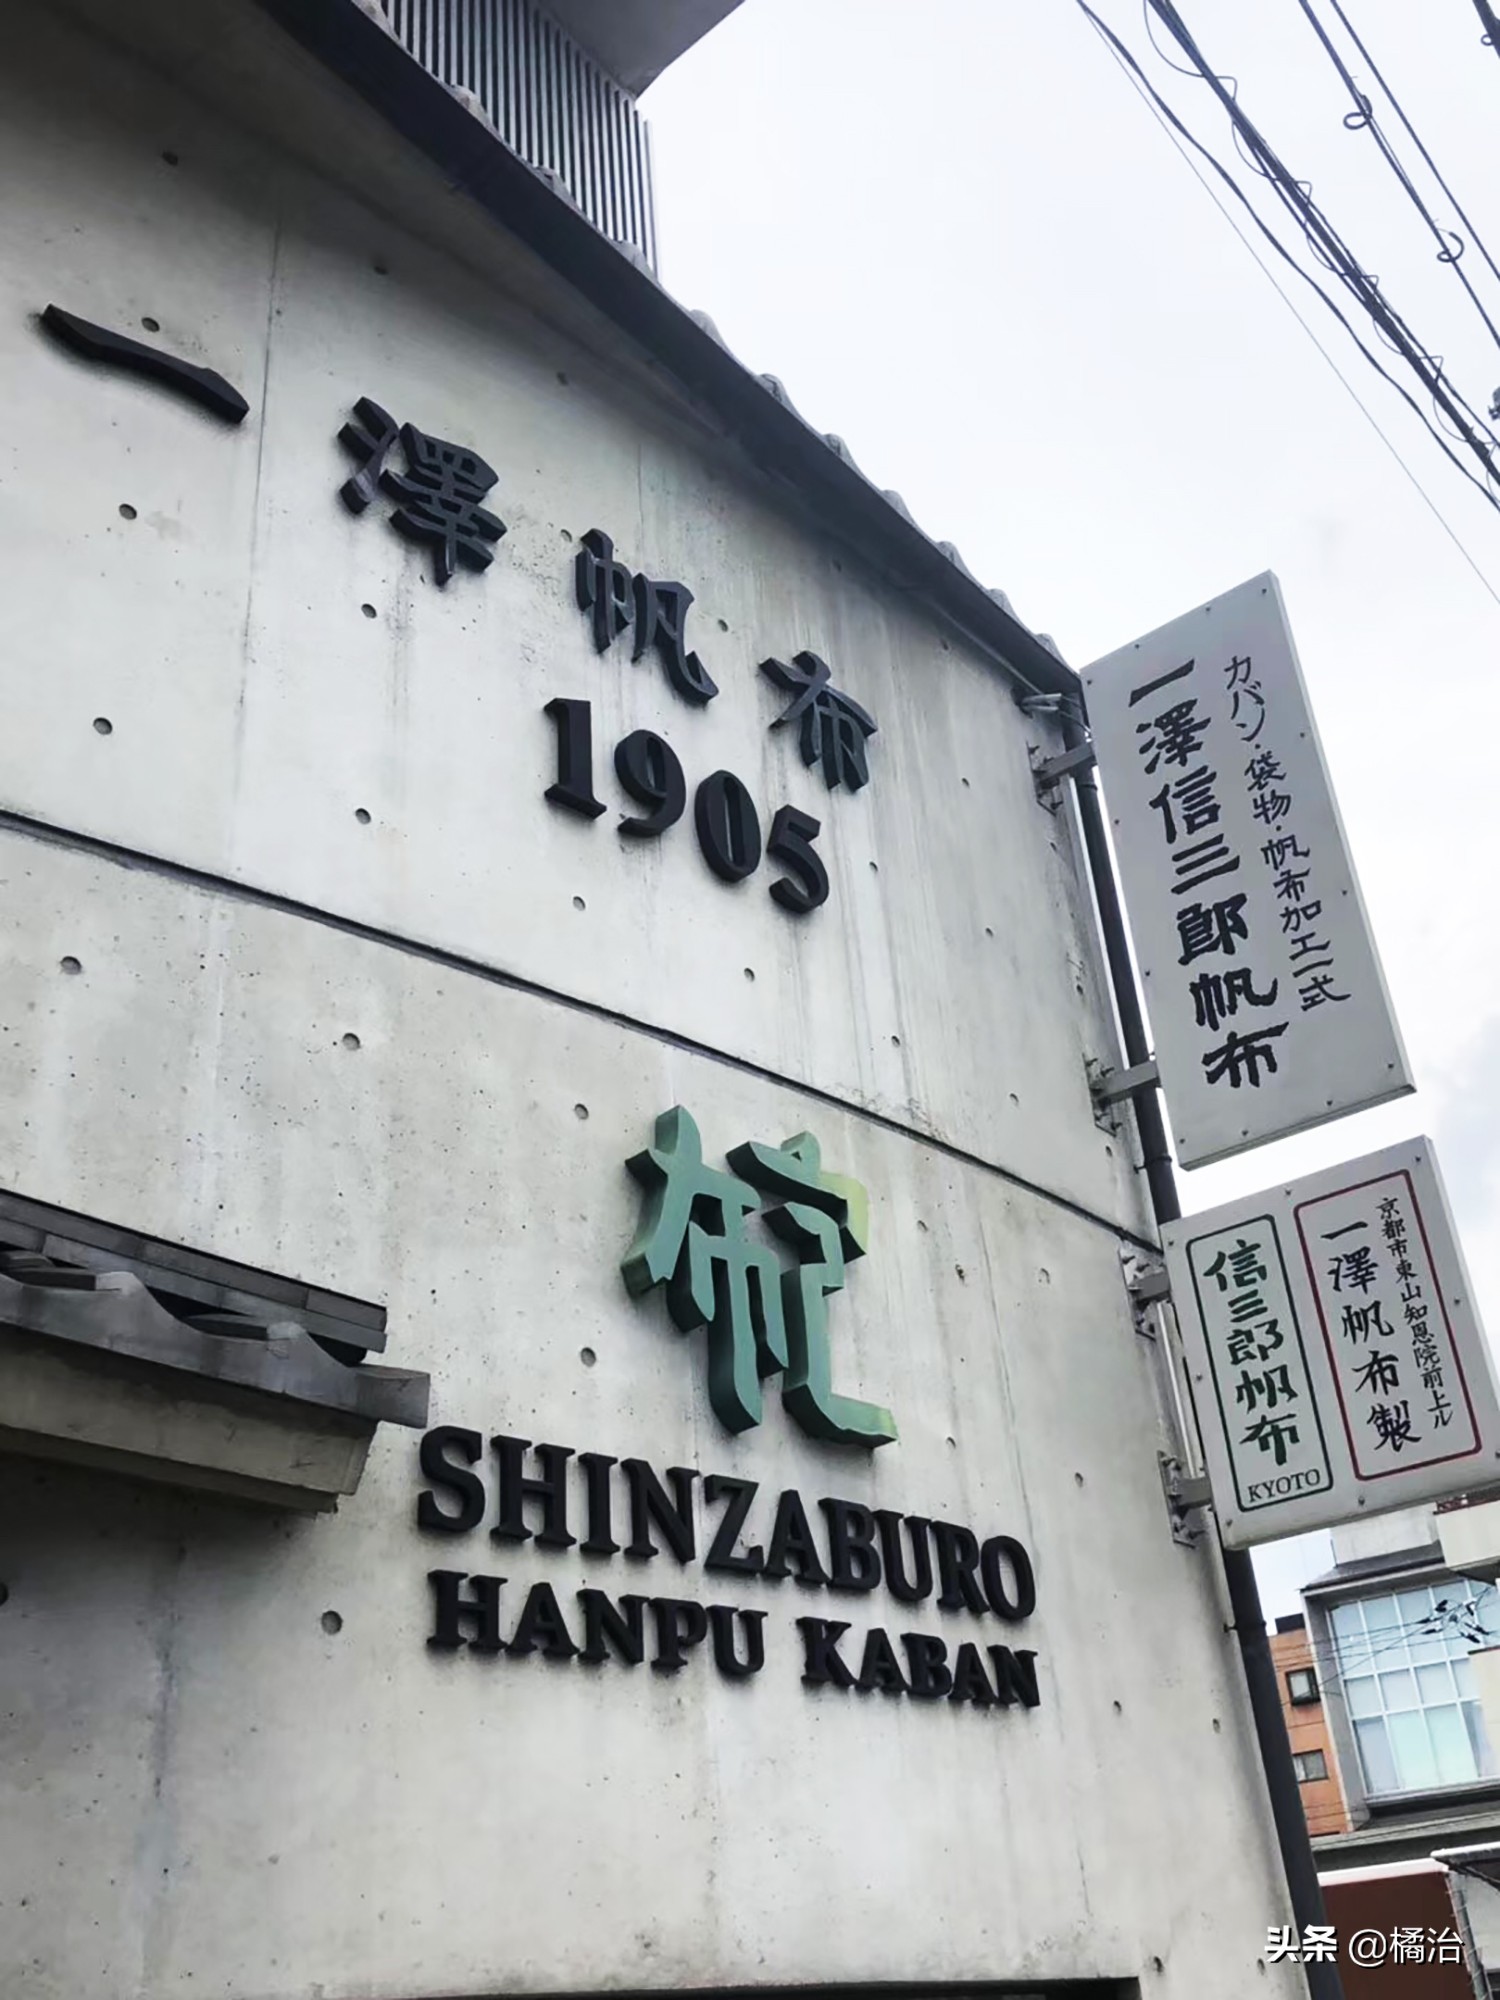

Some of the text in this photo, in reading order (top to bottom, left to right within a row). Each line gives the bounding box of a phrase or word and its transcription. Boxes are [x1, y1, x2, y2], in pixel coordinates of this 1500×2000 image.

[41, 303, 877, 792] 一澤帆布
[543, 697, 831, 914] 1905
[1128, 657, 1290, 1089] 一澤信三郎帆布
[1203, 1238, 1301, 1467] 信三郎帆布
[1320, 1220, 1422, 1454] 一澤帆布製
[1374, 1196, 1453, 1430] 京都市東山知恩院前上ル
[416, 1425, 1037, 1620] SHINZABURO
[1247, 1467, 1321, 1503] KYOTO
[426, 1569, 1041, 1708] HANPU KABAN
